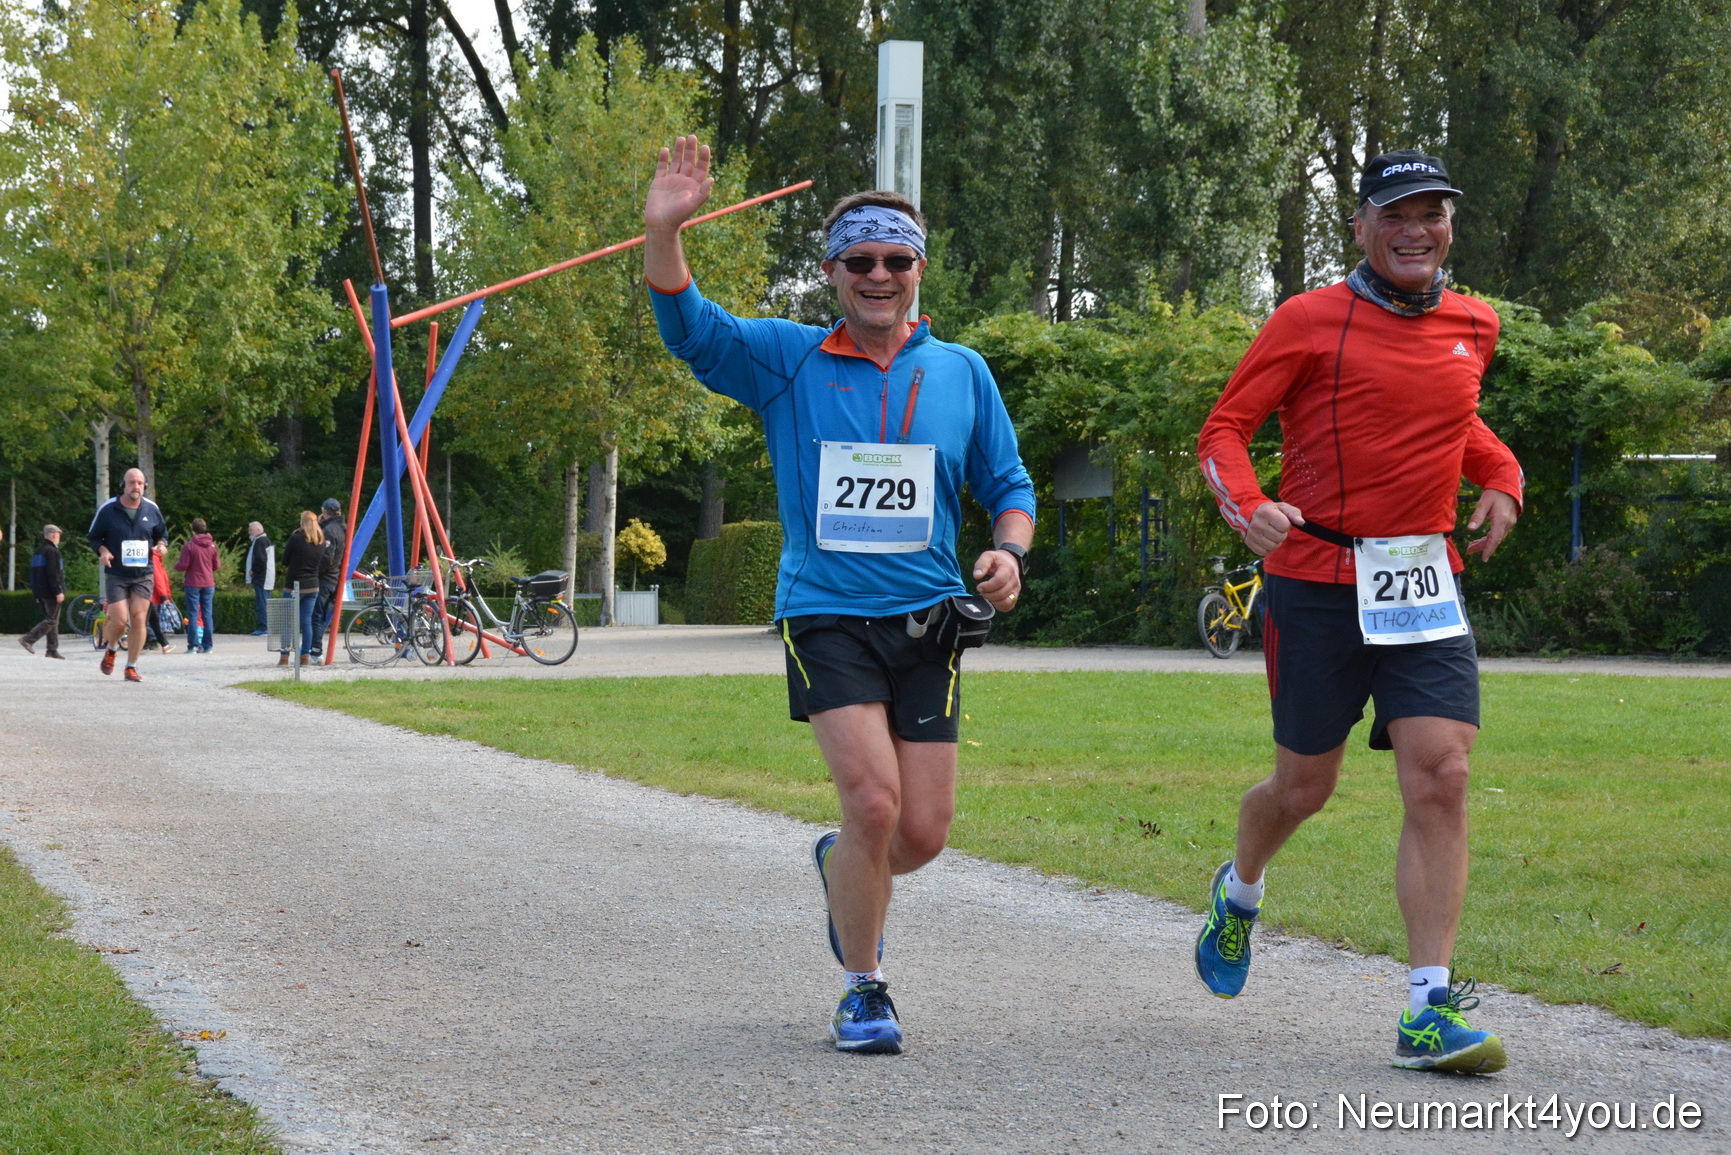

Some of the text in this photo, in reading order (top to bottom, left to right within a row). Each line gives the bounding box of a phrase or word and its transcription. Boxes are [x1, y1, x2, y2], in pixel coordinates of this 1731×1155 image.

[1382, 162, 1428, 178] CRAFT
[863, 453, 902, 464] BOCK
[835, 476, 916, 511] 2729
[832, 521, 883, 534] Christian
[126, 548, 145, 557] 2187
[1373, 565, 1440, 603] 2730
[1367, 607, 1448, 630] THOMAS
